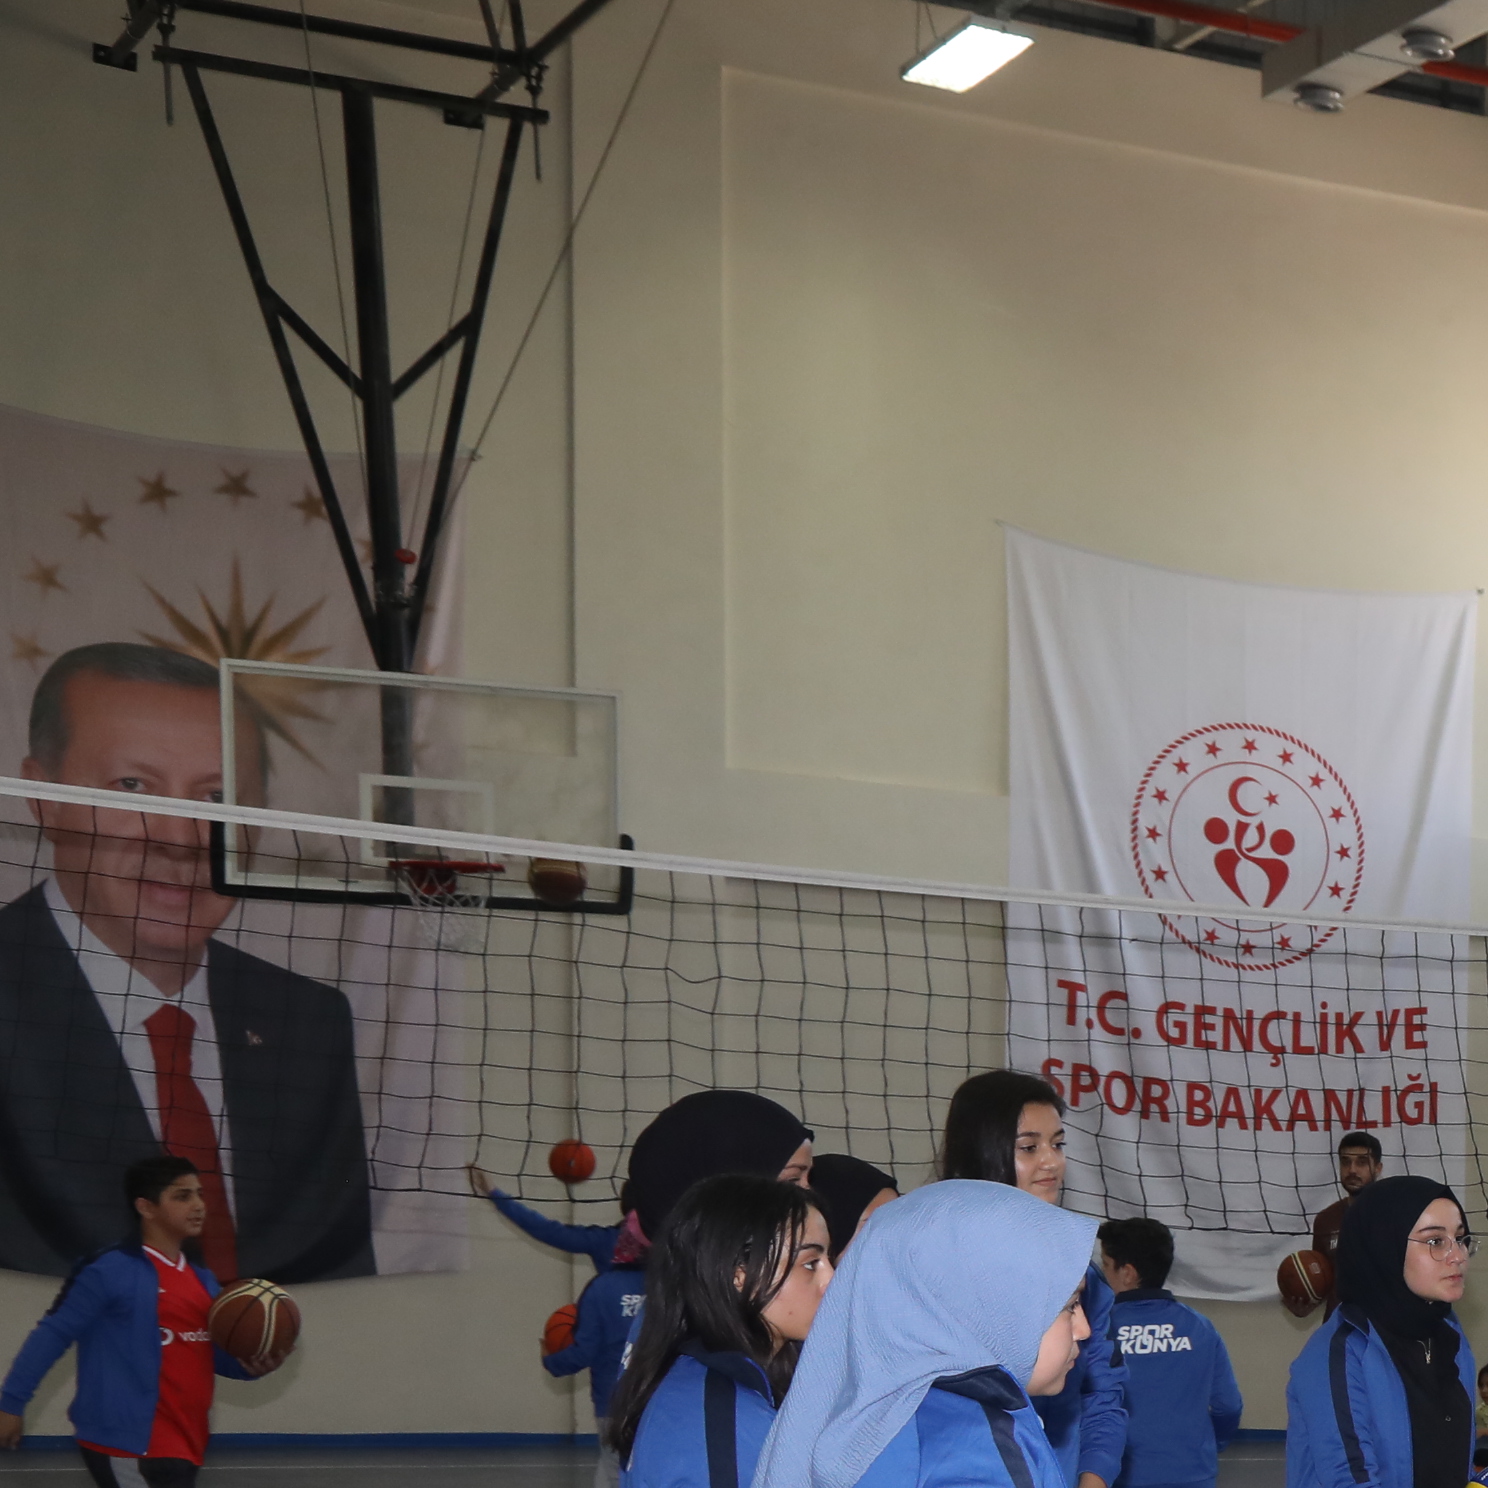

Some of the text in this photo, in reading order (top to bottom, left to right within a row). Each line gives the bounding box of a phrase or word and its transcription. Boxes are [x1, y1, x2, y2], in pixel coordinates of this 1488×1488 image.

[1057, 979, 1429, 1067] T.C. GENÇLİK VE
[1040, 1057, 1438, 1133] SPOR BAKANLIĞI
[1117, 1324, 1174, 1341] SPOR
[1120, 1335, 1192, 1354] KONYA
